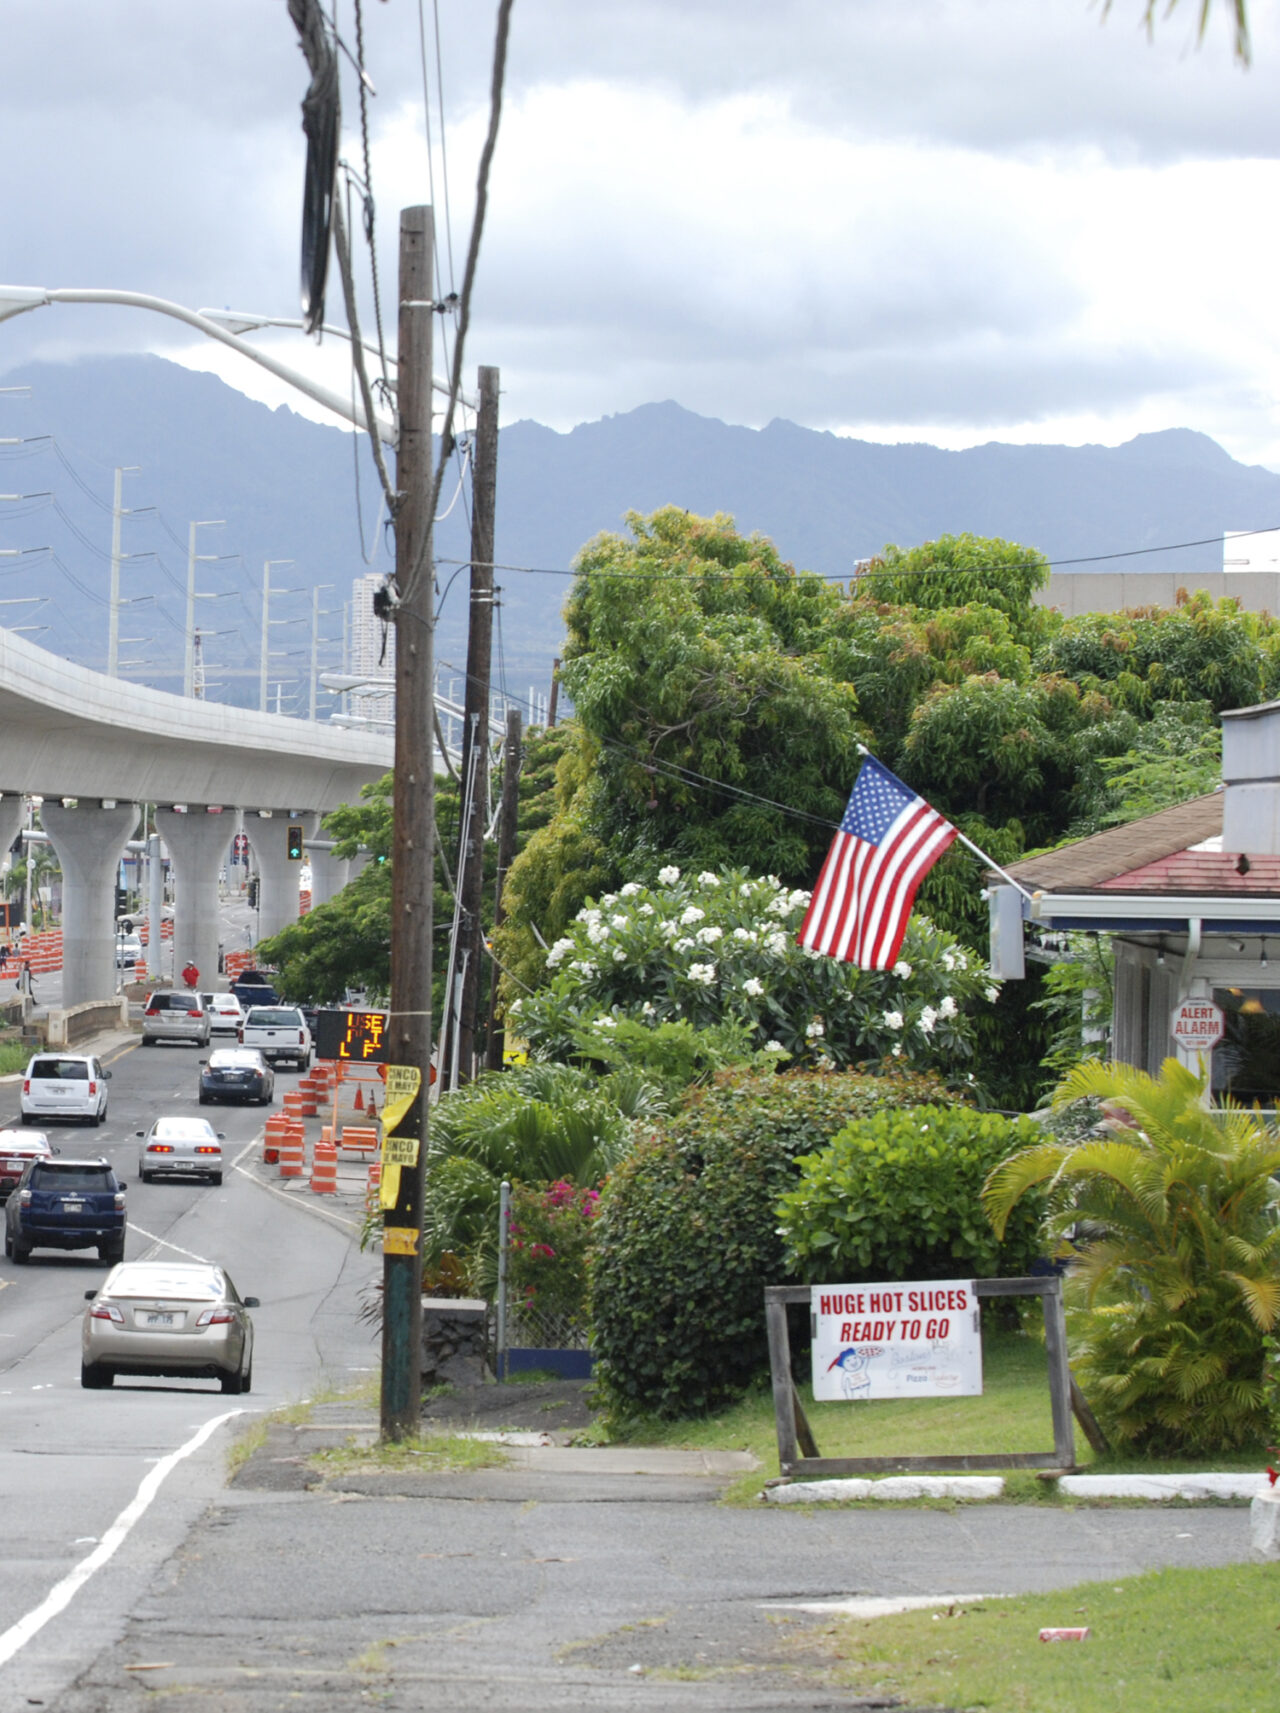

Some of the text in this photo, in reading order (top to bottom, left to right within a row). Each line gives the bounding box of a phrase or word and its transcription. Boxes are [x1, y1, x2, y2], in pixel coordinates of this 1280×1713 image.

[1181, 1007, 1214, 1019] ALERT
[1175, 1021, 1219, 1035] ALARM
[391, 1154, 414, 1163] MAYO
[820, 1290, 968, 1316] HUGE HOT SLICES
[840, 1318, 950, 1342] READY TO GO
